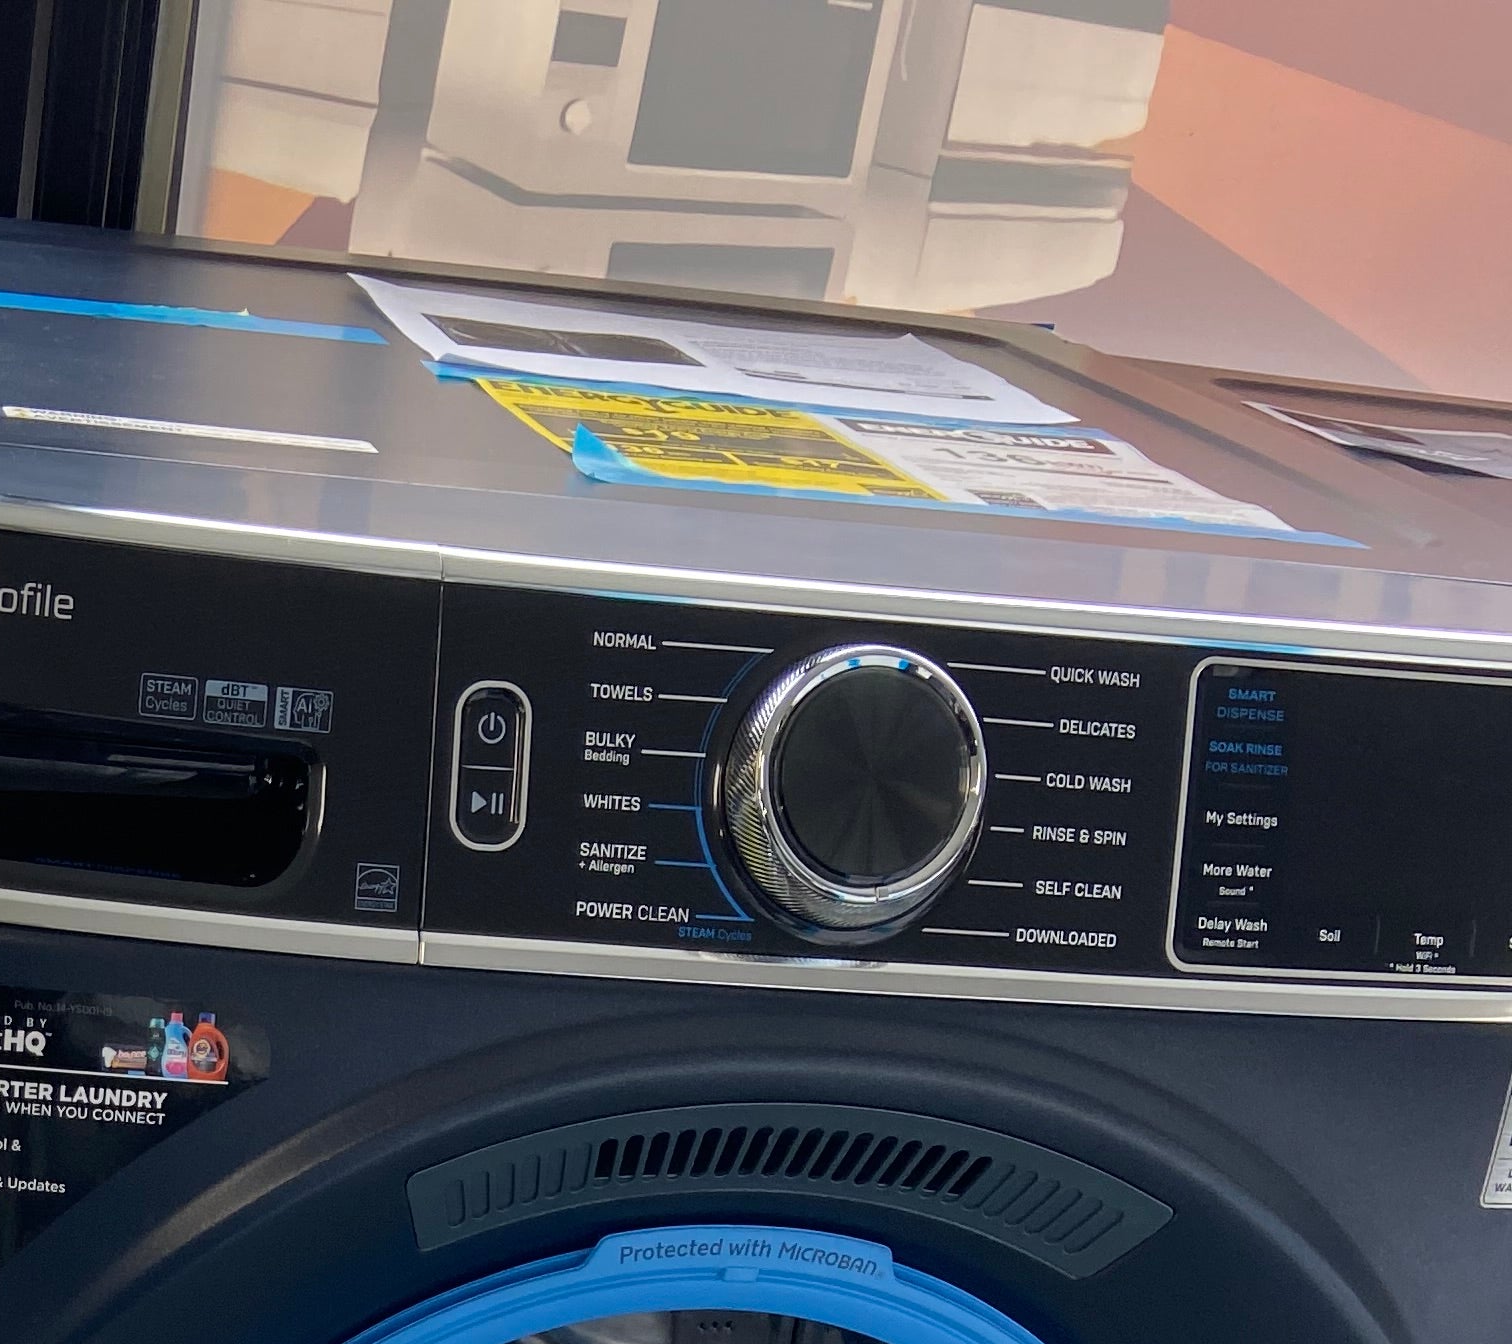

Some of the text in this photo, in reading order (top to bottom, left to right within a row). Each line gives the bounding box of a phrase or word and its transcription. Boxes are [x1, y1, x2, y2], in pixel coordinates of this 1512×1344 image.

[592, 631, 657, 651] NORMAL
[1050, 666, 1140, 687] QUICK WASH
[146, 680, 192, 695] STEAM
[590, 683, 653, 702] TOWELS
[1228, 688, 1276, 701] SMART
[146, 695, 188, 712] Cycles
[218, 699, 250, 711] QUIET
[207, 711, 260, 725] CONTROL
[1217, 706, 1284, 722] DISPENSE
[1058, 719, 1136, 739] DELICATES
[584, 731, 635, 749] BULKY
[1209, 740, 1283, 756] SOAK RINSE
[584, 749, 630, 766] Bedding
[1205, 761, 1288, 776] FOR SANITIZER
[1045, 773, 1131, 794] COLD WASH
[583, 794, 641, 812] WHITES
[1206, 811, 1278, 829] My Settings
[1032, 826, 1126, 846] RINSE & SPIN
[579, 843, 647, 862] SANITIZE
[588, 860, 635, 875] Allergen
[1203, 864, 1272, 878] More Water
[1035, 880, 1122, 900] SELF CLEAN
[576, 902, 689, 923] POWER CLEAN
[1198, 917, 1268, 933] Delay Wash
[678, 926, 753, 943] STEAM Cycles
[1016, 928, 1116, 948] DOWNLOADED
[1202, 938, 1259, 948] Remote Start
[1319, 929, 1341, 942] Soil
[1414, 933, 1444, 948] Temp
[1415, 964, 1421, 973] 3
[27, 1017, 48, 1029] BY
[60, 1084, 168, 1110] LAUNDRY
[6, 1101, 52, 1117] WHEN
[57, 1105, 88, 1121] YOU
[92, 1108, 166, 1125] CONNECT
[11, 1138, 21, 1152] &
[7, 1177, 66, 1195] Updates
[620, 1239, 877, 1276] Protected with MICROBAN
